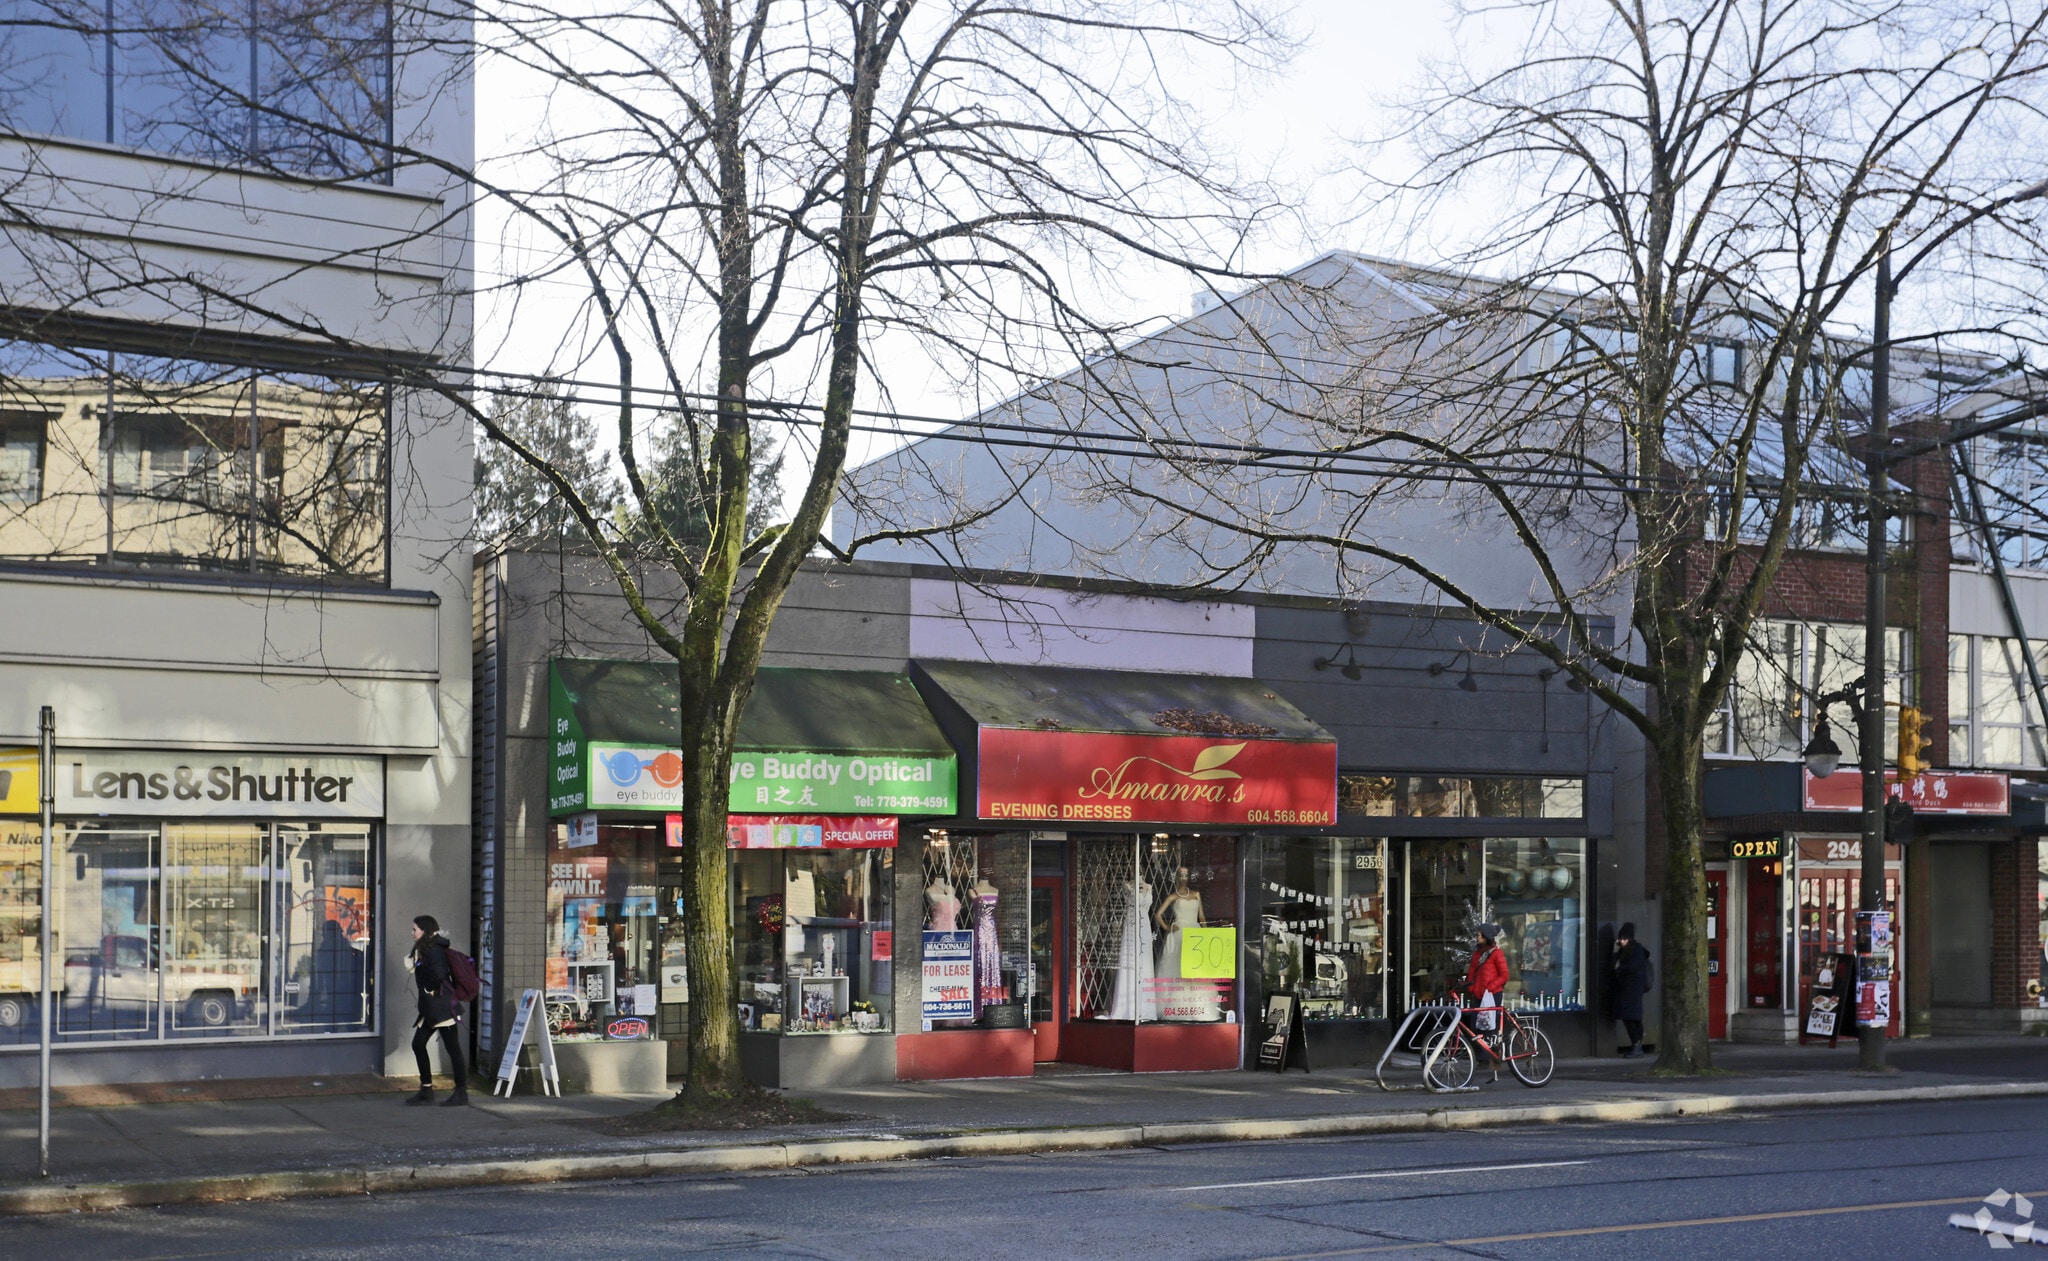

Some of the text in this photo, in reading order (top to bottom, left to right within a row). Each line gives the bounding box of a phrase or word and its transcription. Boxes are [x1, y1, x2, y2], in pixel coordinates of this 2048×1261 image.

[557, 718, 569, 736] Eye
[557, 738, 577, 757] Buddy
[557, 762, 579, 784] Optical
[729, 757, 932, 786] ye Buddy Optical
[72, 762, 354, 803] Lens&Shutter
[616, 789, 678, 802] eye buddy
[756, 785, 818, 807] 目之友
[854, 795, 949, 809] Tel: 778-379-4591
[991, 802, 1133, 820] EVENING DRESSES
[1247, 809, 1330, 824] 604.568.6604
[7, 833, 54, 845] Niko
[825, 829, 894, 842] SPECIAL OFFER
[1733, 840, 1778, 857] OPEN
[1827, 840, 1862, 859] 294
[1357, 856, 1384, 868] 2936
[551, 863, 593, 879] SEE IT.
[551, 880, 605, 895] OWN IT.
[926, 942, 970, 951] MACDONALD
[923, 964, 971, 976] FOR LEASE
[941, 986, 970, 1002] SALE
[981, 986, 1009, 999] SALE
[608, 1022, 648, 1035] OPEN
